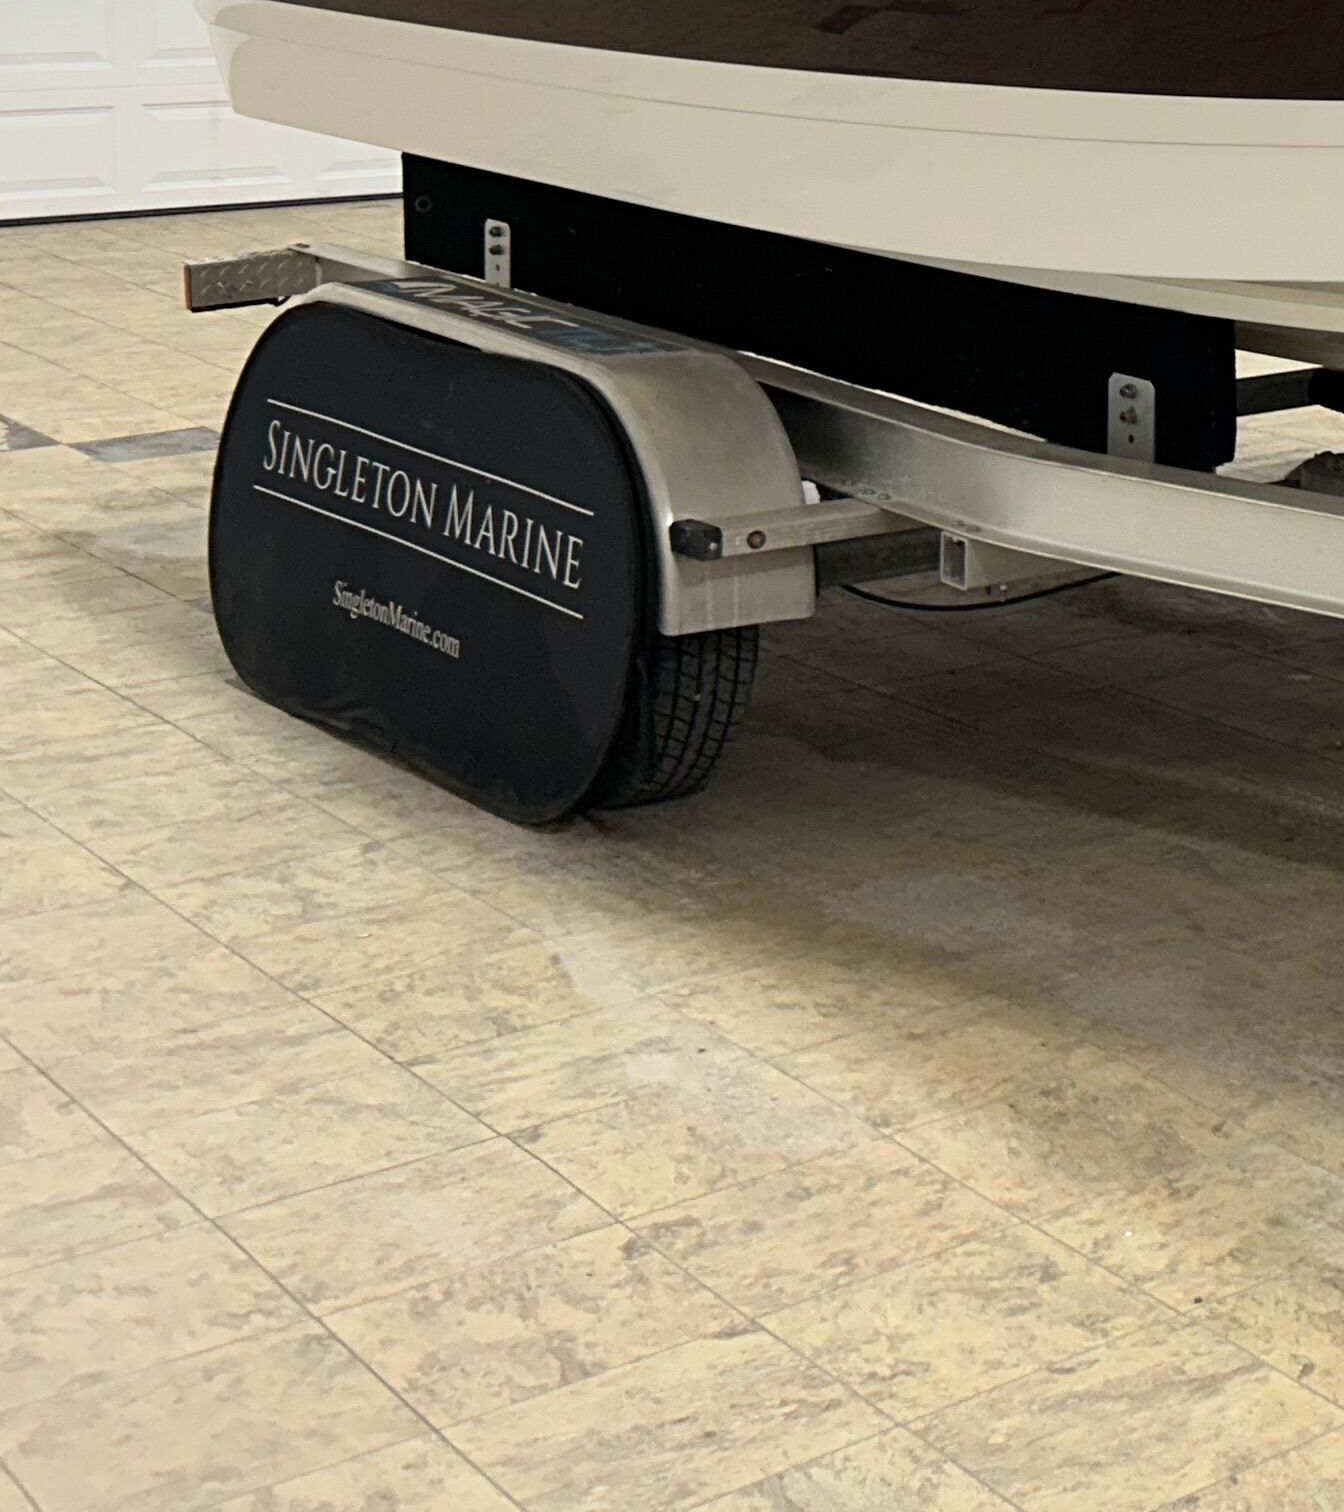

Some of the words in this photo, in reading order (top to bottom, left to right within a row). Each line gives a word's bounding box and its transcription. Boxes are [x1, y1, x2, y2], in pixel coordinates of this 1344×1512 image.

[263, 420, 438, 529] SINGLETON
[443, 484, 583, 589] MARINE
[332, 580, 460, 659] SingletonMarine.com
